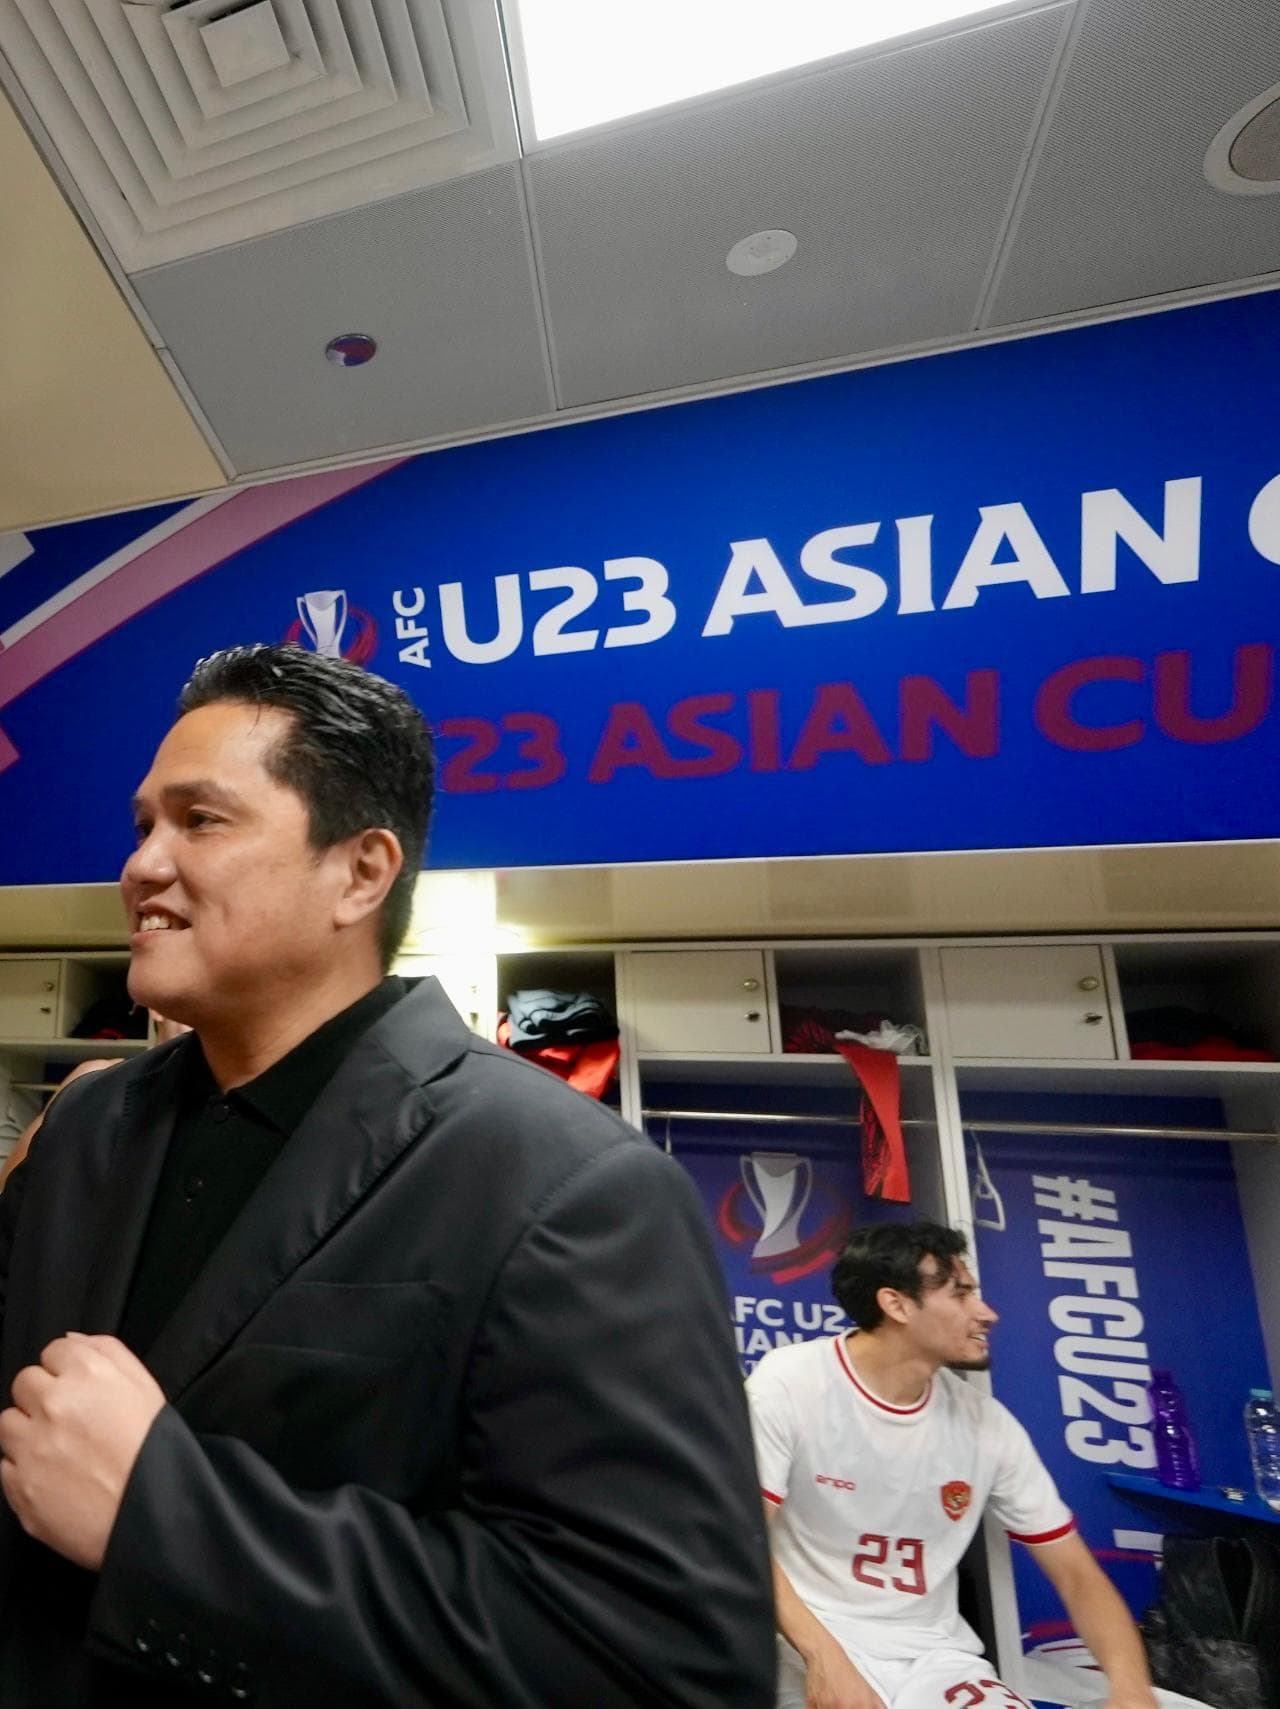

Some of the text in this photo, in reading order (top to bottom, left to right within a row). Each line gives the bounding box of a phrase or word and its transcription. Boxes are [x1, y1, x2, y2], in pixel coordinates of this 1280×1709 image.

[439, 557, 677, 664] U23
[701, 476, 1202, 637] ASIAN
[393, 587, 431, 668] AFC
[587, 668, 1000, 785] ASIAN
[730, 1296, 856, 1333] FC U2
[1031, 1174, 1159, 1469] #AFCU23
[852, 1533, 927, 1596] 23
